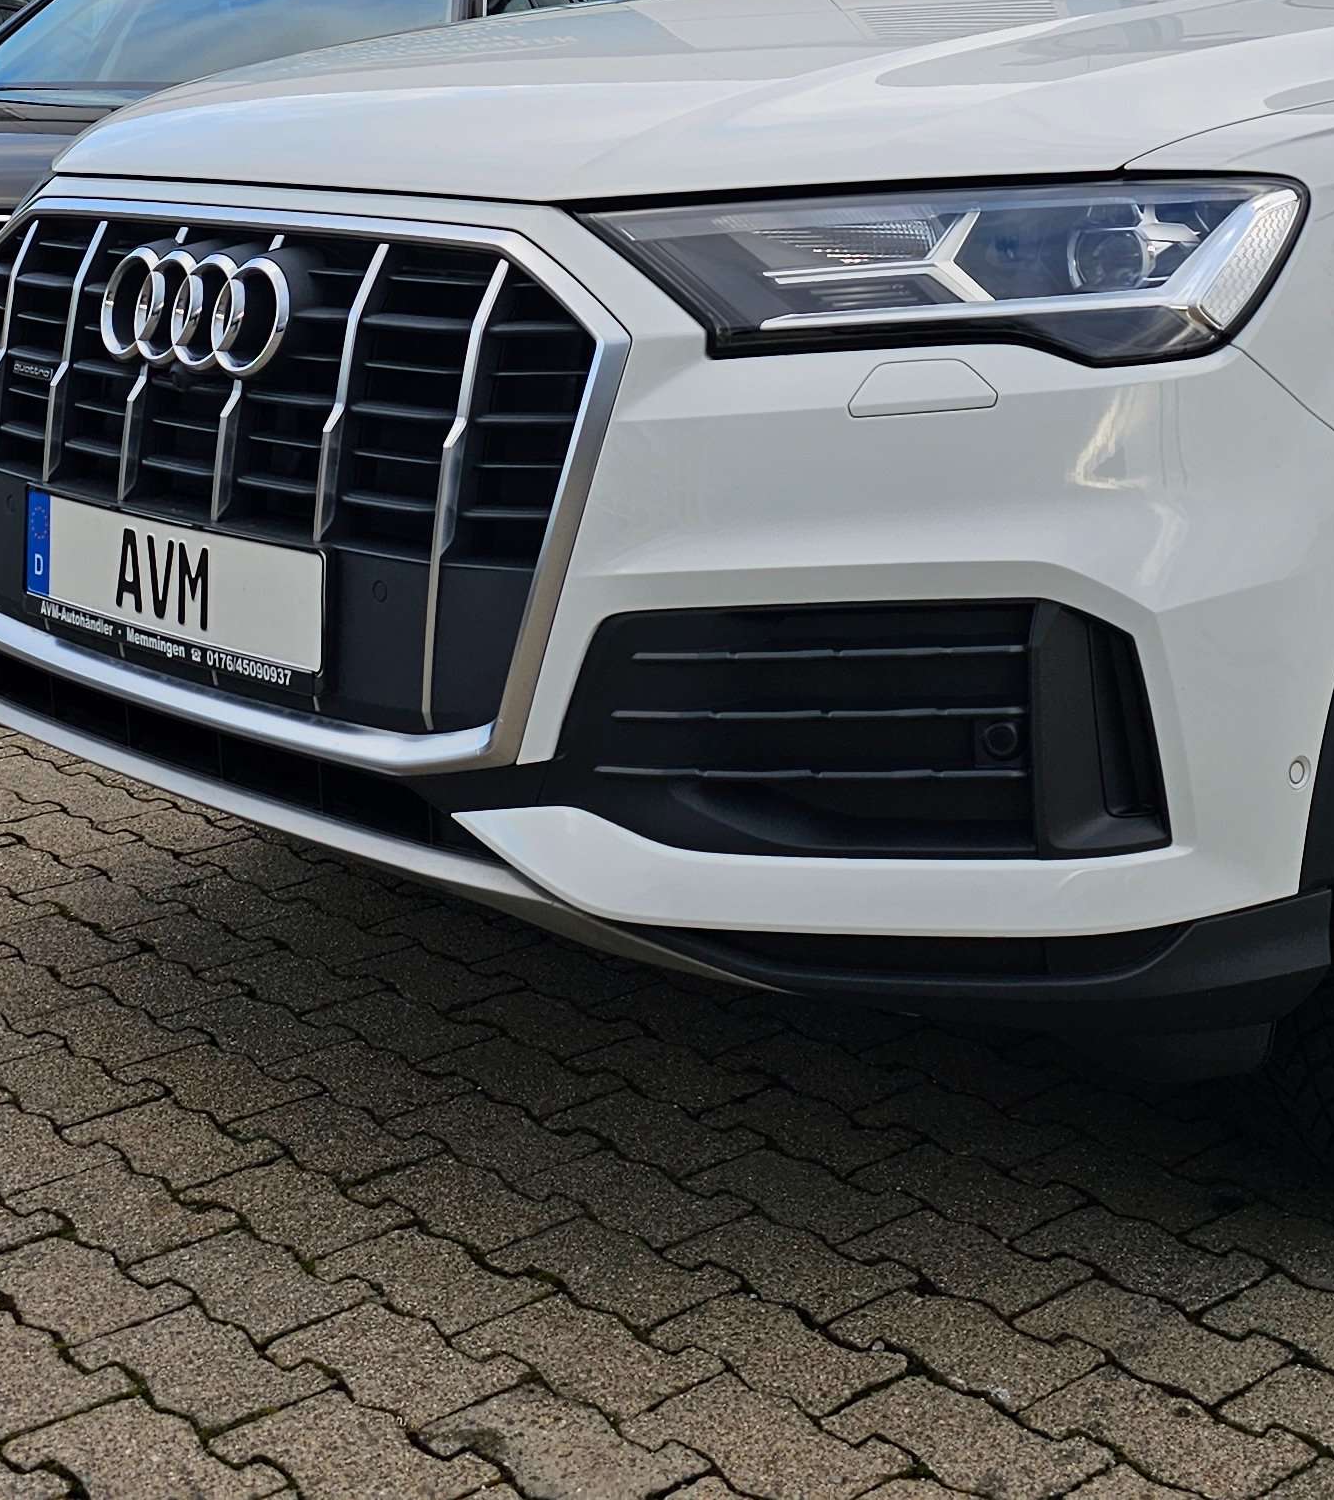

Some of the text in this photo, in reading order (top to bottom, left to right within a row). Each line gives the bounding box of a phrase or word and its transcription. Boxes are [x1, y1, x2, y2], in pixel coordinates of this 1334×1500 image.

[13, 363, 50, 378] quattro
[34, 527, 210, 631] D AVM
[40, 600, 292, 687] AVM-Autohändler Memmingen 0176/45090937
